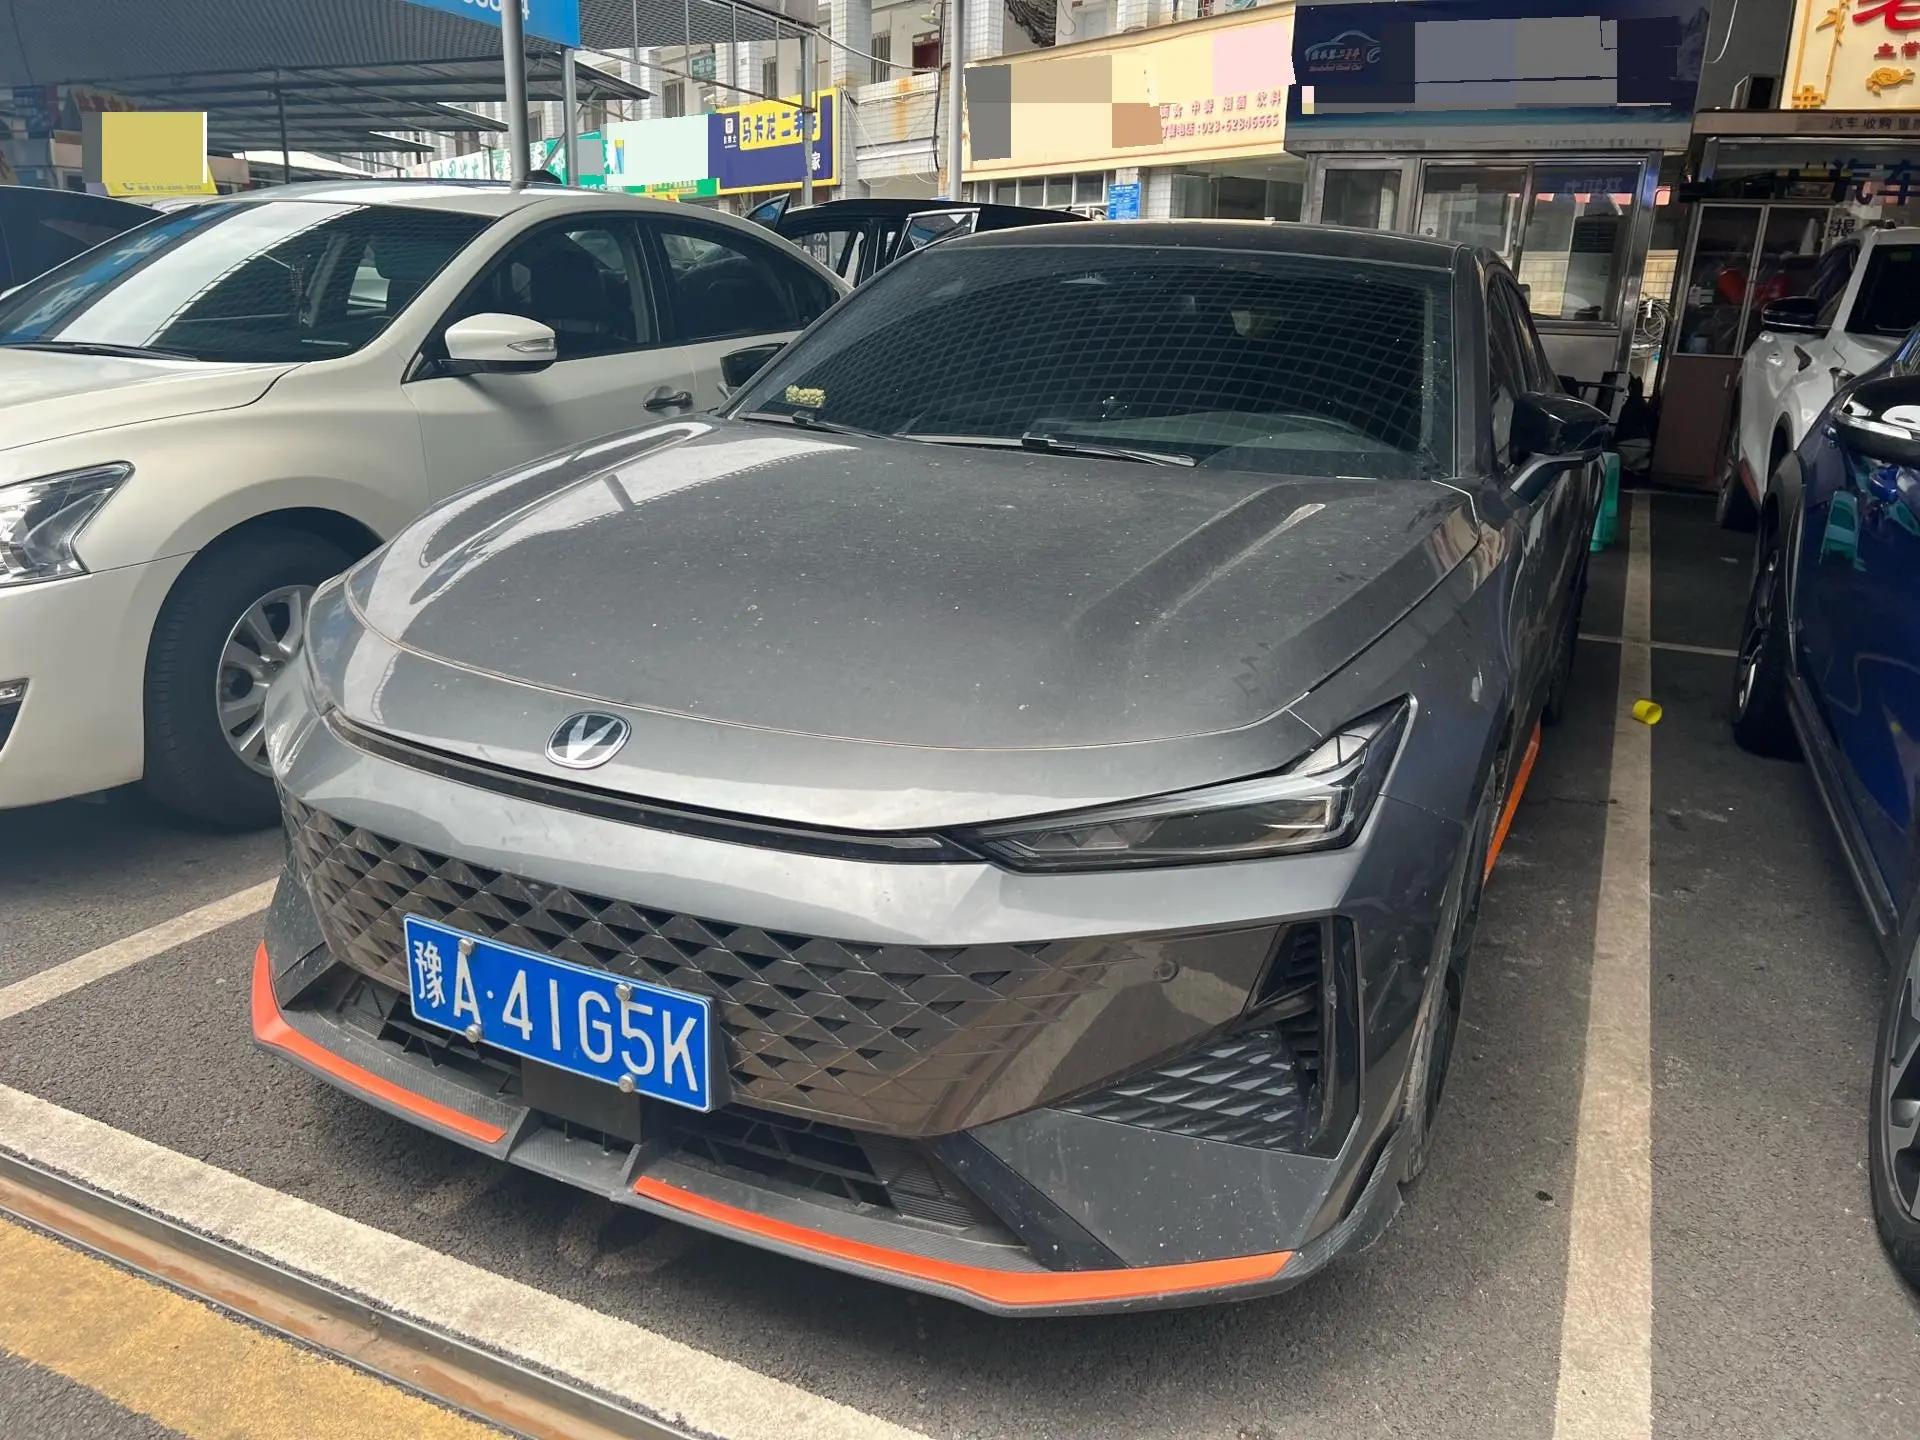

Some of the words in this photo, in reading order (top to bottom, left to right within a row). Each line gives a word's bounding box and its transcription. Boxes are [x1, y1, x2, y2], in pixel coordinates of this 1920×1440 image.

[1191, 99, 1215, 115] 中餐
[1222, 95, 1247, 112] 烟酒
[1257, 90, 1281, 108] 饮料
